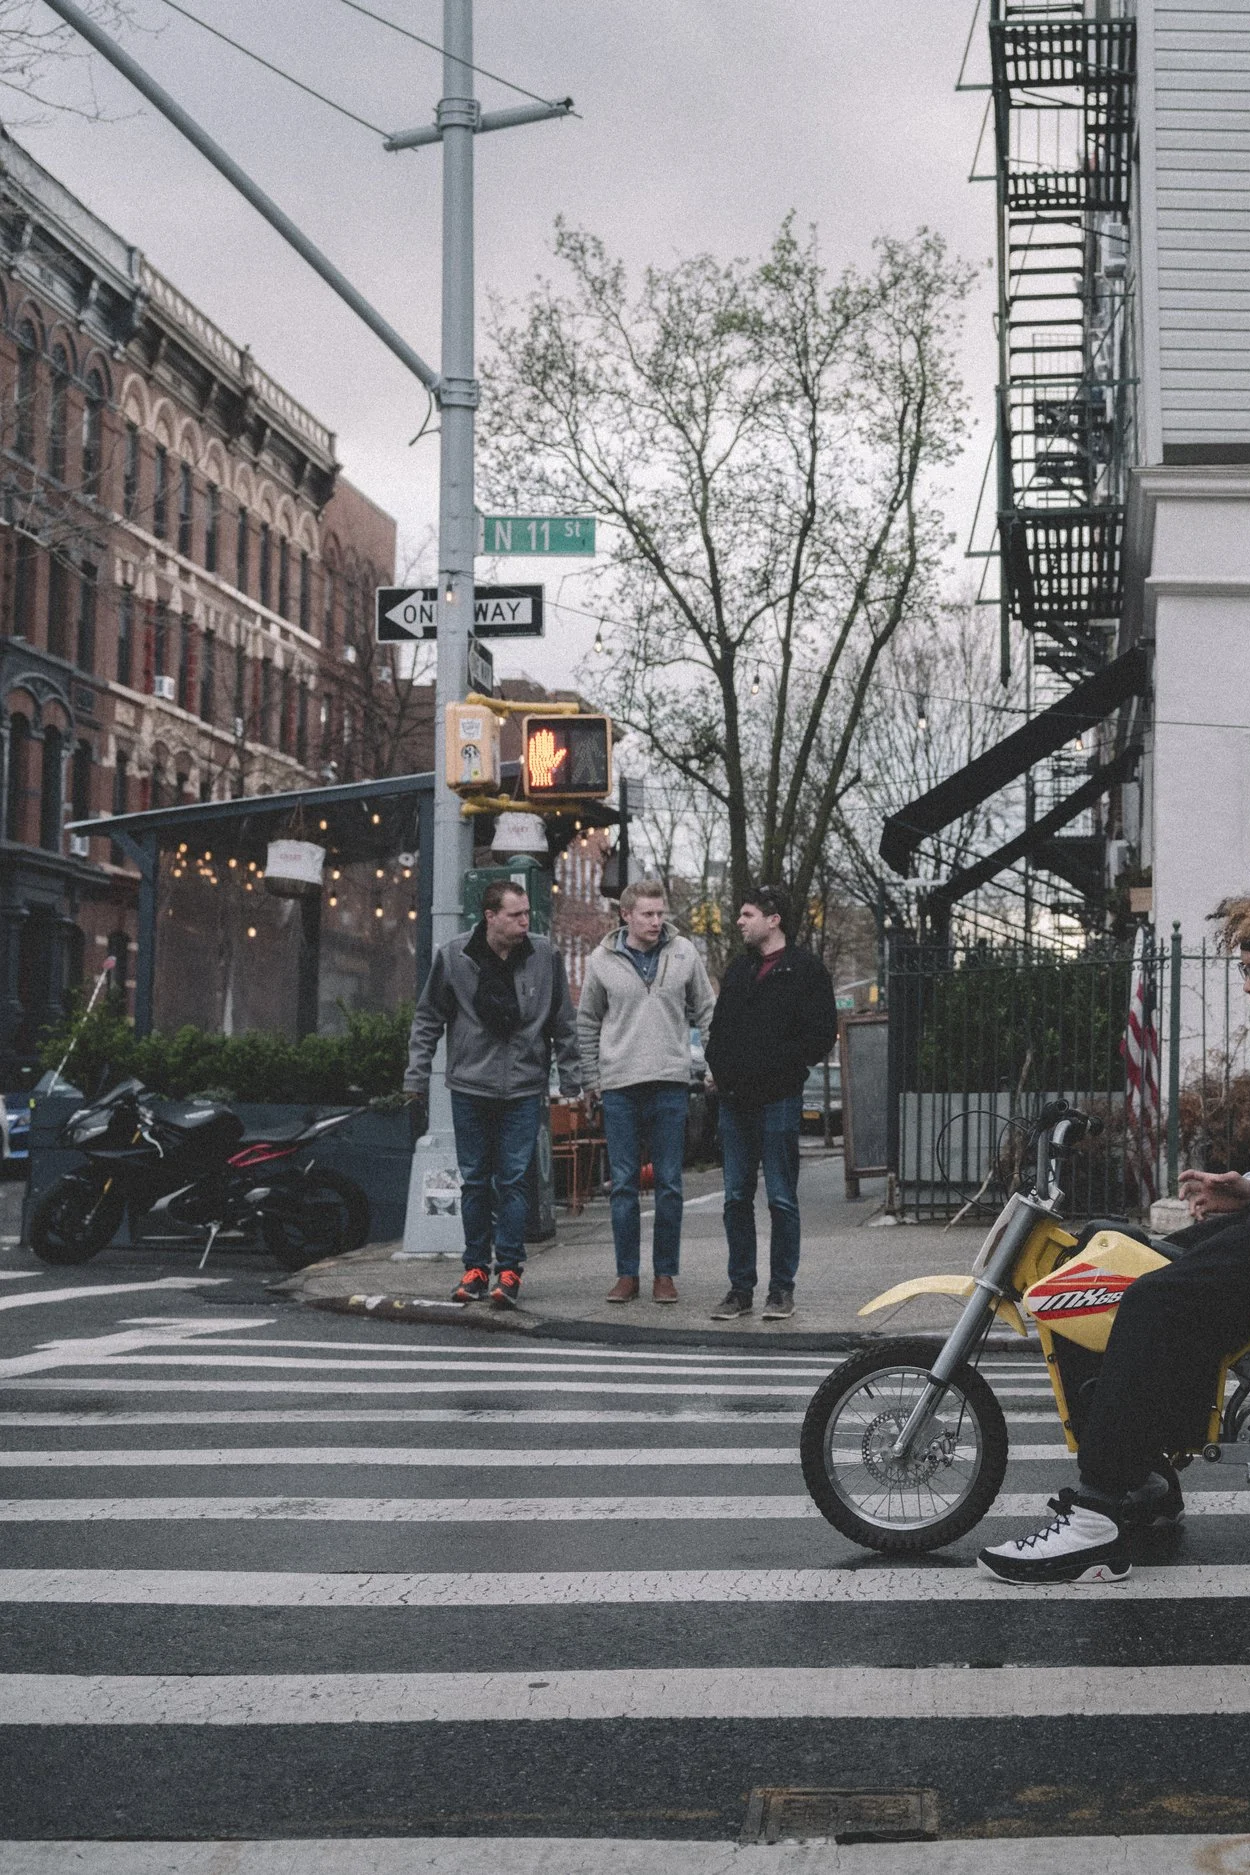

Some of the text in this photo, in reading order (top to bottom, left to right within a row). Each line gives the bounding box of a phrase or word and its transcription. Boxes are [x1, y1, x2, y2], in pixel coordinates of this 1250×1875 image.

[494, 519, 581, 551] N 11 St
[403, 602, 521, 624] ON WAY
